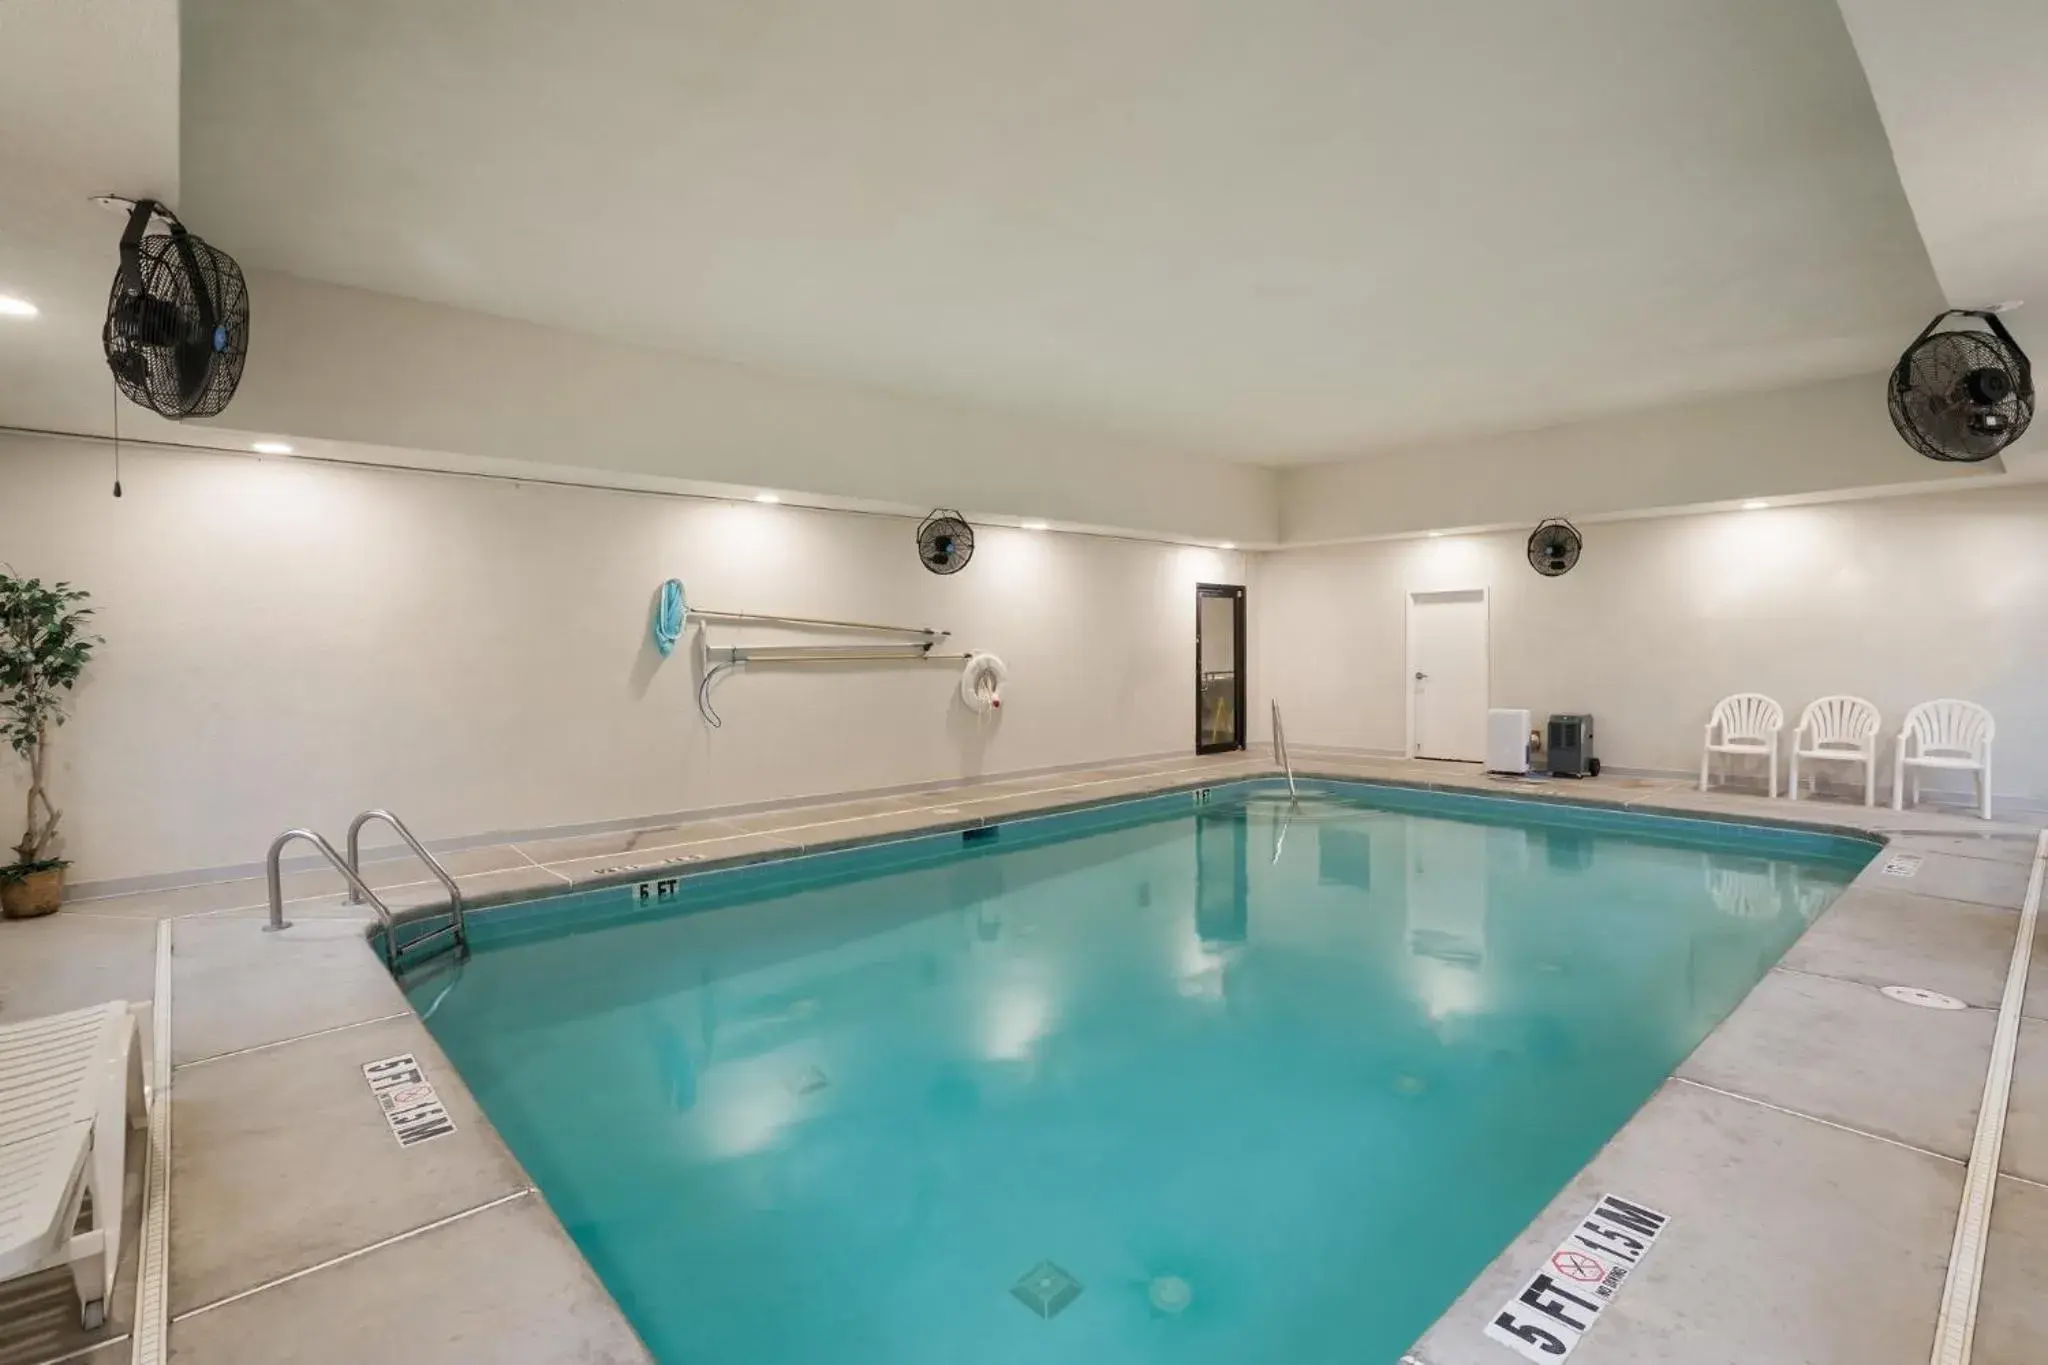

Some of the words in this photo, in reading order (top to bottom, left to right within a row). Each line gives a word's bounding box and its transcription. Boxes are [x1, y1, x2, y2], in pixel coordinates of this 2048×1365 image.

[657, 879, 677, 896] FT
[367, 1057, 413, 1072] 5
[372, 1068, 422, 1090] FT
[1519, 1273, 1599, 1331] FT
[1494, 1311, 1566, 1354] 5
